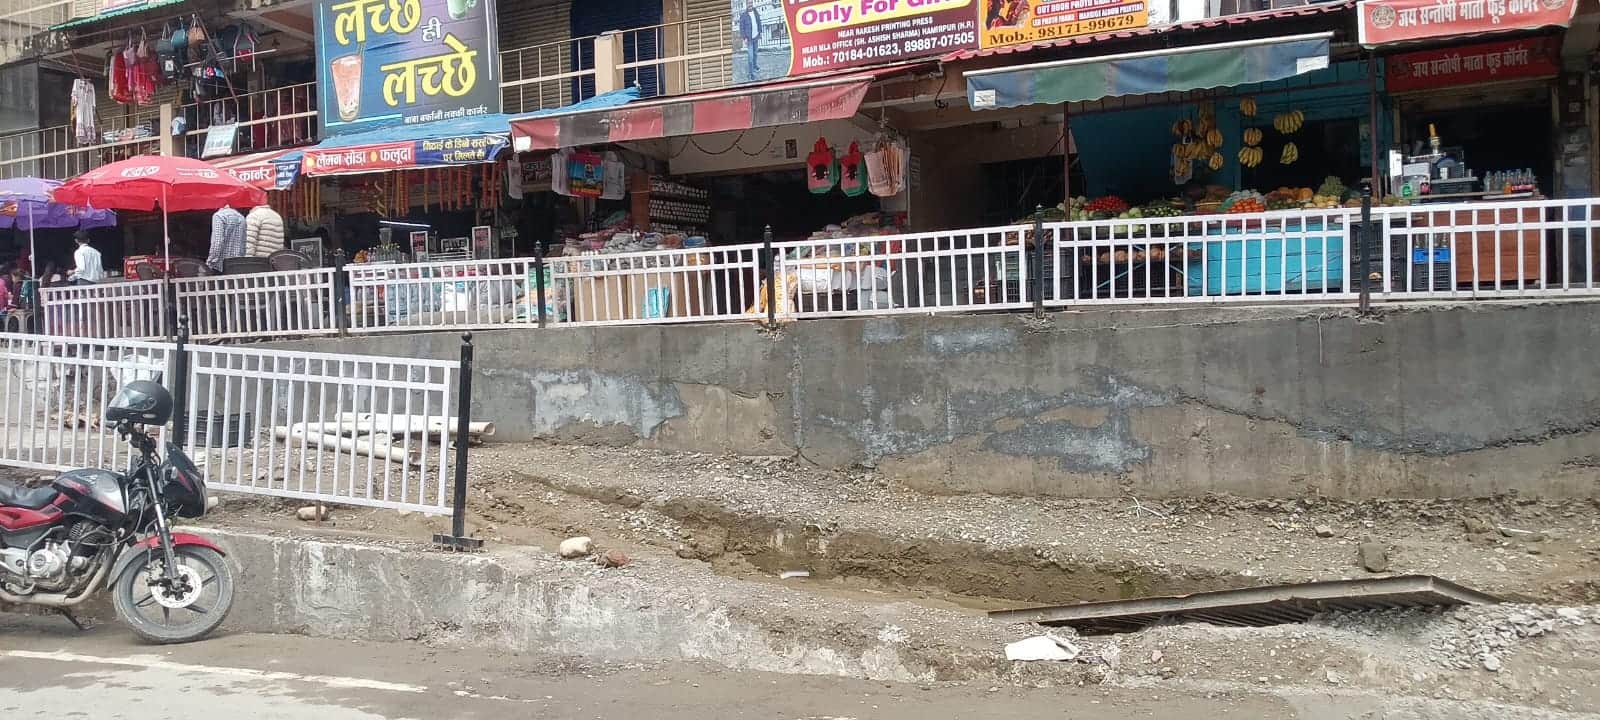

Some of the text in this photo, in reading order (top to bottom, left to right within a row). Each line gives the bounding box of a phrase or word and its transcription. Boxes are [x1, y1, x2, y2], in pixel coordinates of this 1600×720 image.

[801, 0, 898, 26] Only For
[1398, 8, 1417, 26] जय
[1419, 0, 1457, 25] सन्तोषी
[1459, 0, 1484, 20] माता
[421, 17, 442, 42] ही
[802, 44, 818, 54] NEAR
[819, 42, 831, 52] MLA
[832, 39, 853, 50] OFFICE
[868, 34, 891, 44] ASHISH
[892, 29, 920, 41] SHARMA)
[922, 23, 957, 36] HAMIRPUR
[838, 16, 934, 39] NEAR RAKESH PRINTING PRESS
[989, 15, 1135, 46] Mob.: 98171-99679
[803, 31, 975, 69] Mob.: 70184-01623, 89887-07505
[381, 34, 477, 107] लच्छे
[1412, 62, 1429, 77] जय
[1463, 55, 1484, 72] माता
[1486, 53, 1501, 74] फूड
[380, 147, 412, 164] फलूदा
[445, 137, 454, 150] के
